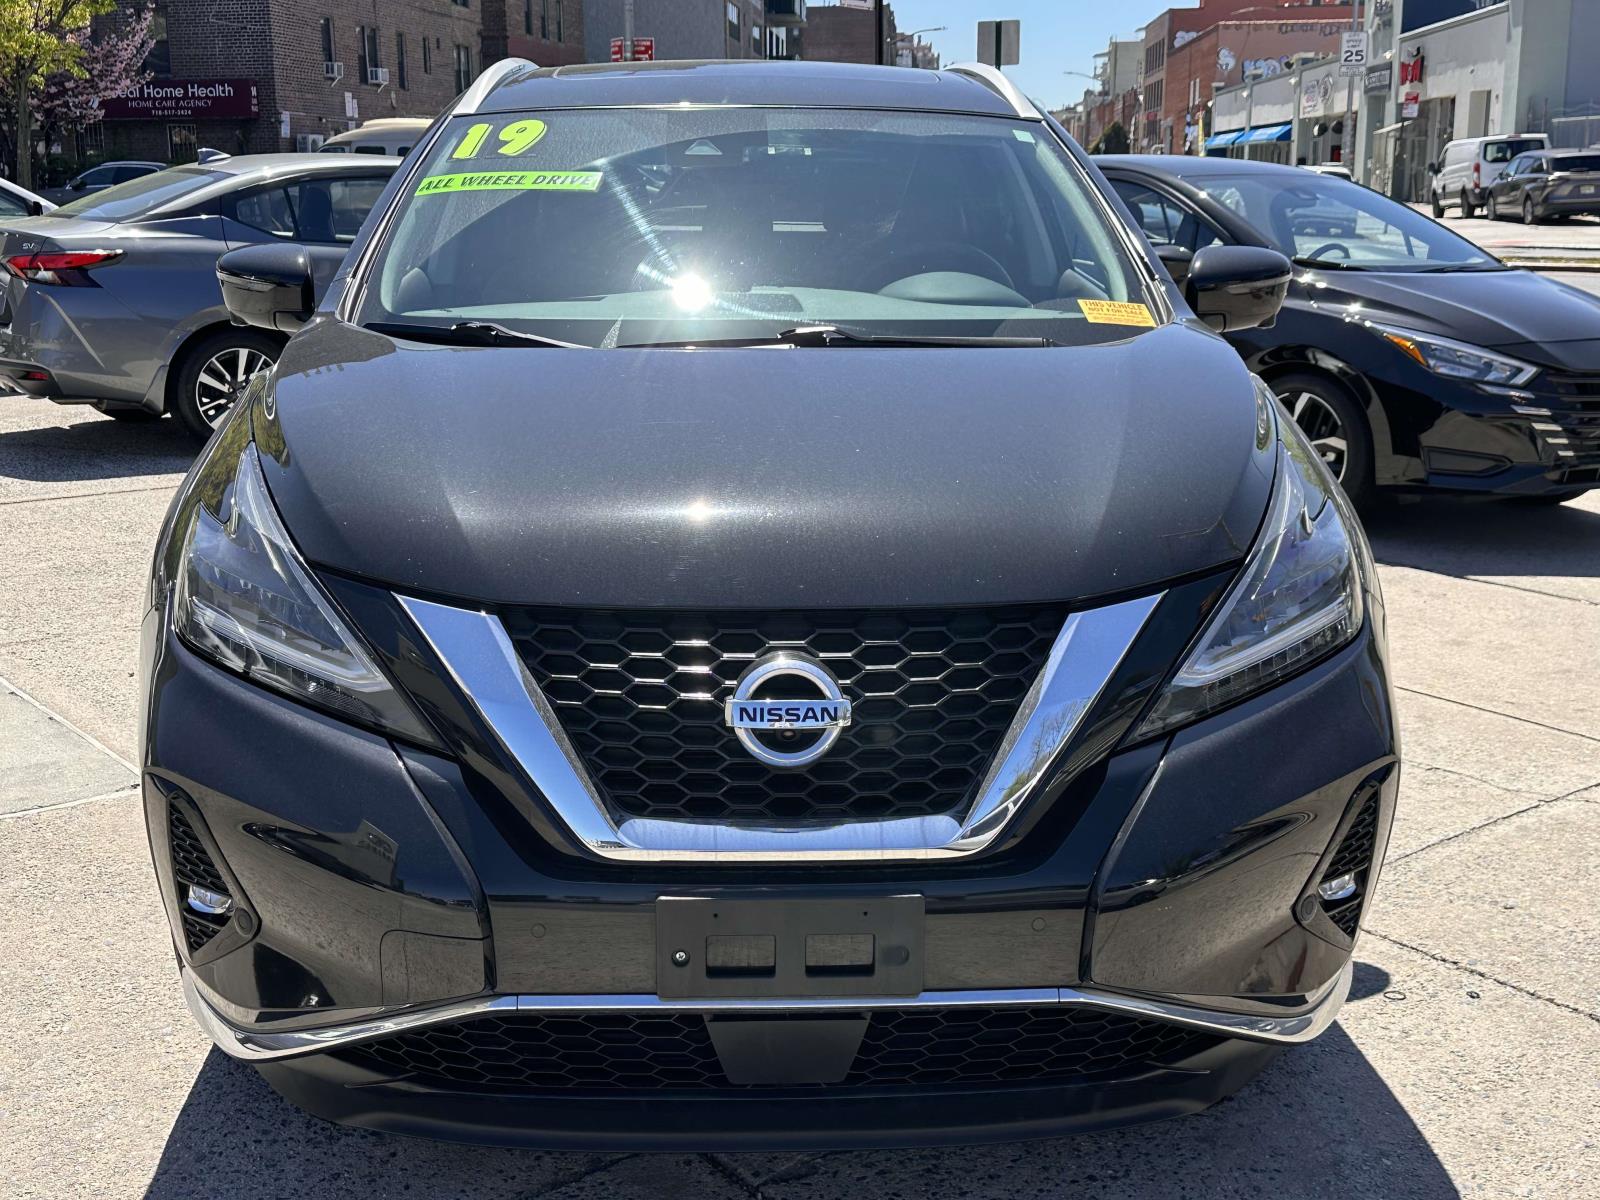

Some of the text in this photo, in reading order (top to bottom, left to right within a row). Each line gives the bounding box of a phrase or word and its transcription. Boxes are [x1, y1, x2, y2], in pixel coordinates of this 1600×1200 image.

[1344, 50, 1364, 62] 25
[144, 84, 184, 98] Home
[187, 83, 234, 97] Health
[128, 100, 153, 108] HOME
[178, 99, 212, 107] AGENCY
[452, 119, 547, 159] 19
[418, 175, 595, 192] ALL WHEEL DRIVE
[1105, 302, 1144, 310] VEHICLE
[739, 707, 838, 723] NISSAN
